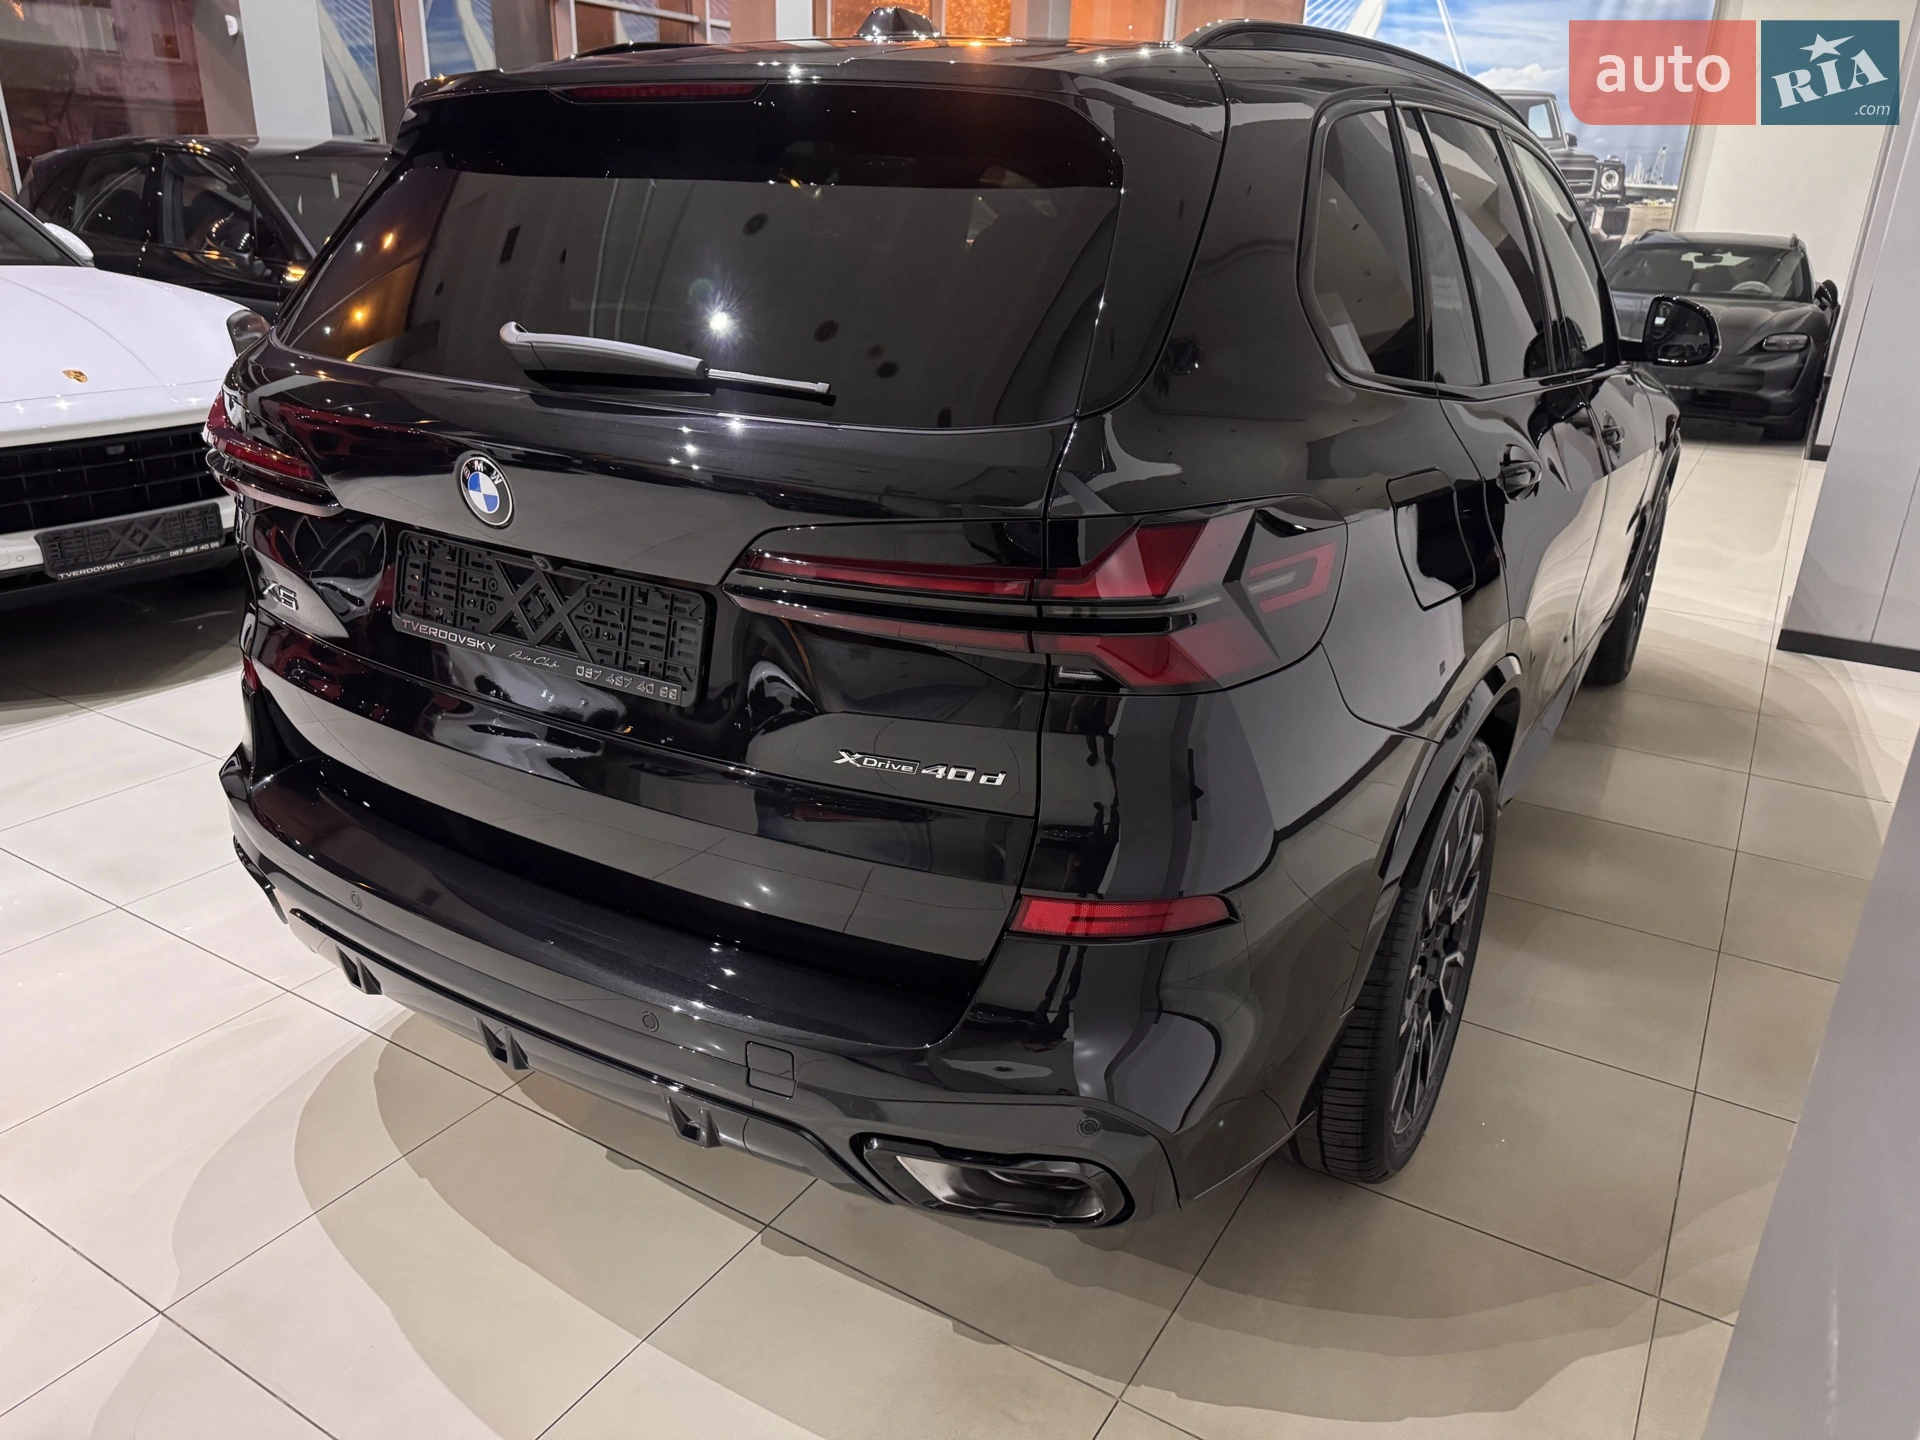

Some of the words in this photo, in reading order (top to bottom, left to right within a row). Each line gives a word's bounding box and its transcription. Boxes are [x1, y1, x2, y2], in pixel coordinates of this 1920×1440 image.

[463, 459, 503, 485] BMW
[58, 561, 125, 579] TVERDOVSKY
[261, 577, 299, 611] X5
[402, 618, 497, 652] TVERDOVSKY
[636, 681, 655, 694] 40
